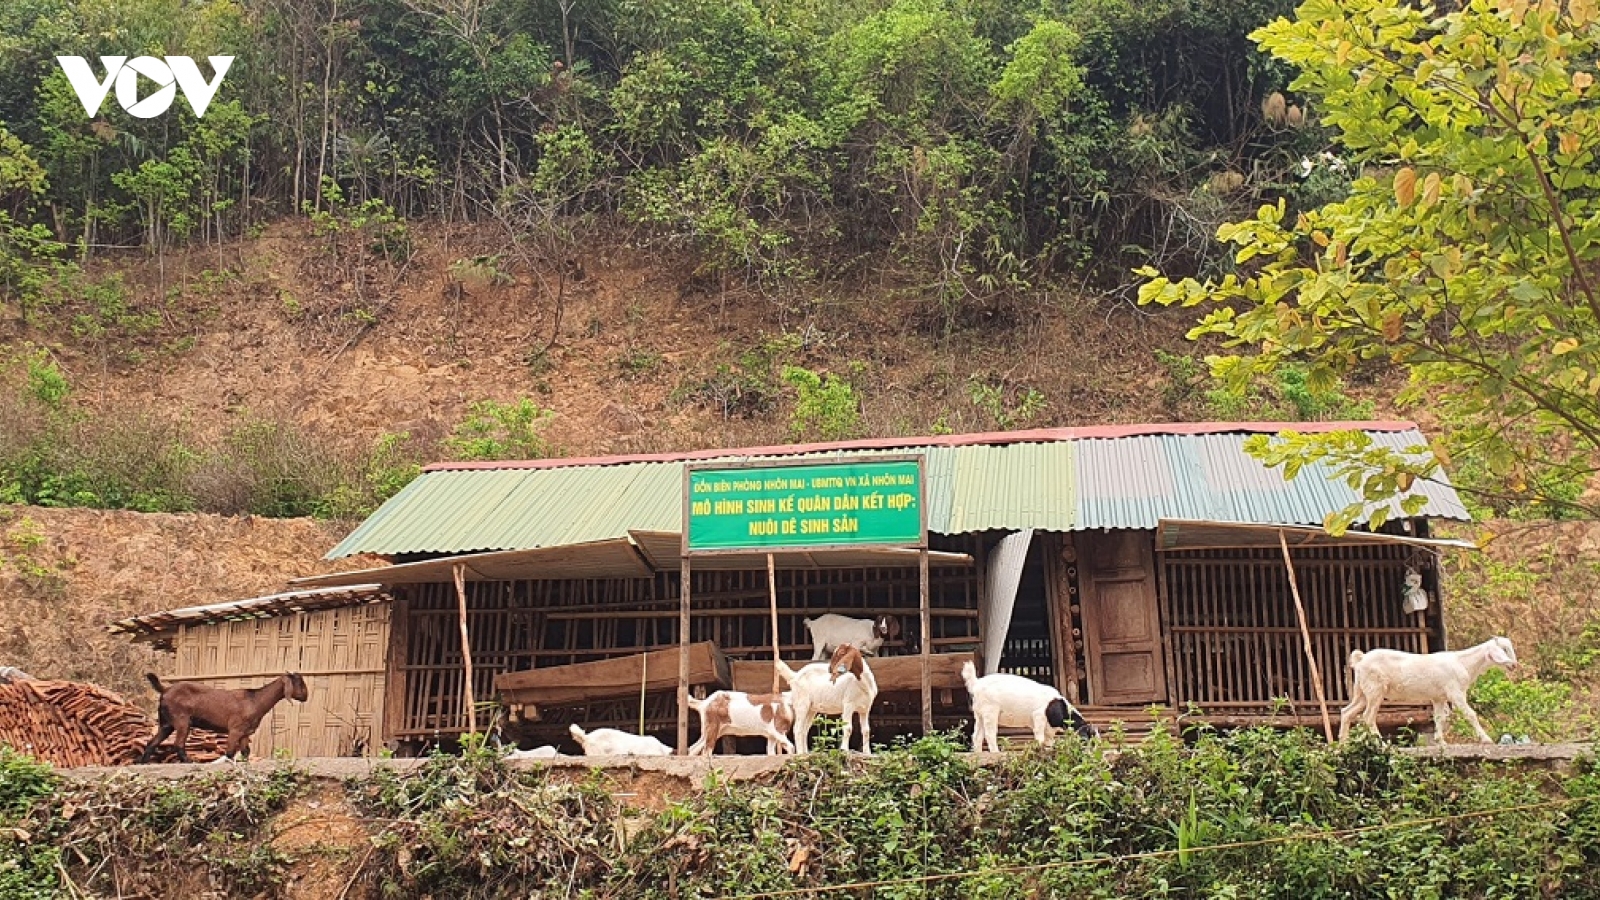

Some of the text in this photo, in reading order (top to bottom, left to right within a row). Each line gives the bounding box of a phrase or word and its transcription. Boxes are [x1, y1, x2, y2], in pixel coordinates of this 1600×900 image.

[714, 480, 731, 492] BIÊN
[733, 478, 761, 492] PHÒNG
[790, 479, 805, 490] MAI
[845, 476, 857, 487] VN
[898, 475, 914, 485] MAI
[692, 491, 916, 516] MÔ HÌNH SINH KẾ QUÂN DÂN KẾT HỢP:
[749, 514, 858, 535] NUÔI DÊ SINH SẢN
